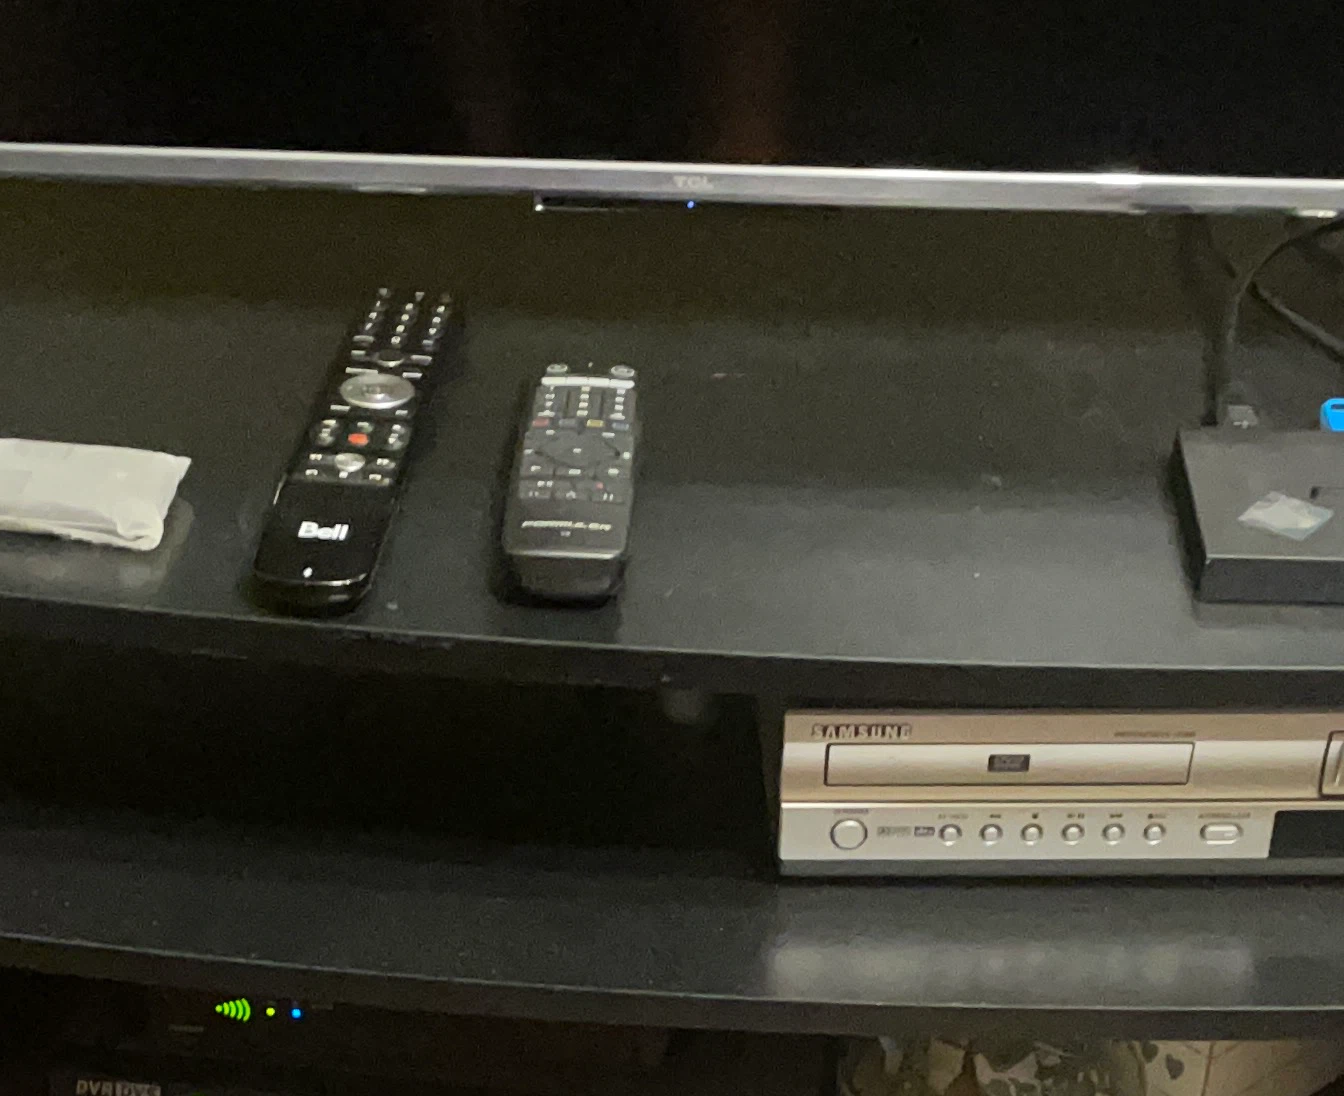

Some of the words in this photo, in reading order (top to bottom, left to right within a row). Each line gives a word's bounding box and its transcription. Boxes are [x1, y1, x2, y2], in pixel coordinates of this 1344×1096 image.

[673, 175, 714, 190] TCL
[298, 520, 349, 541] Bell
[811, 722, 912, 741] SAMSUNG
